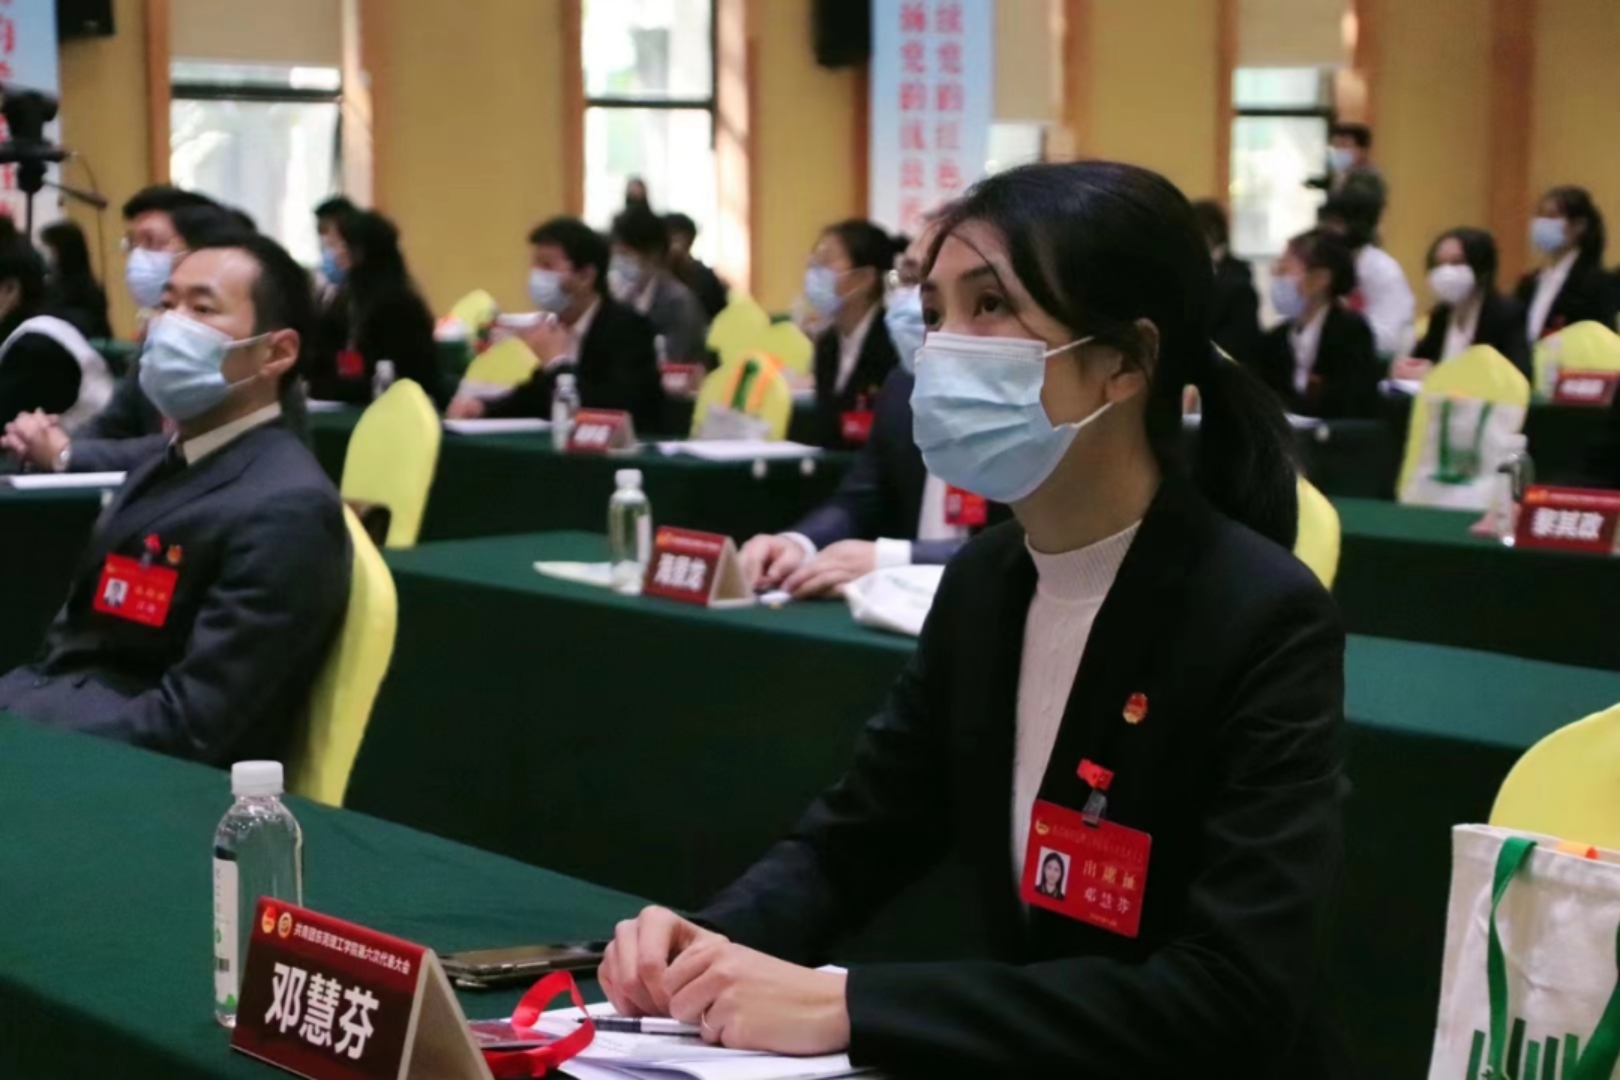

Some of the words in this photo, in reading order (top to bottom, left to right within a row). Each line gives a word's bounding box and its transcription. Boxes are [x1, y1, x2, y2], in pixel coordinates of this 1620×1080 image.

[1083, 886, 1131, 914] 邓慧芬
[294, 922, 411, 976] 共青团东莞理工学院第六次代表大会
[265, 961, 380, 1060] 邓慧芬
